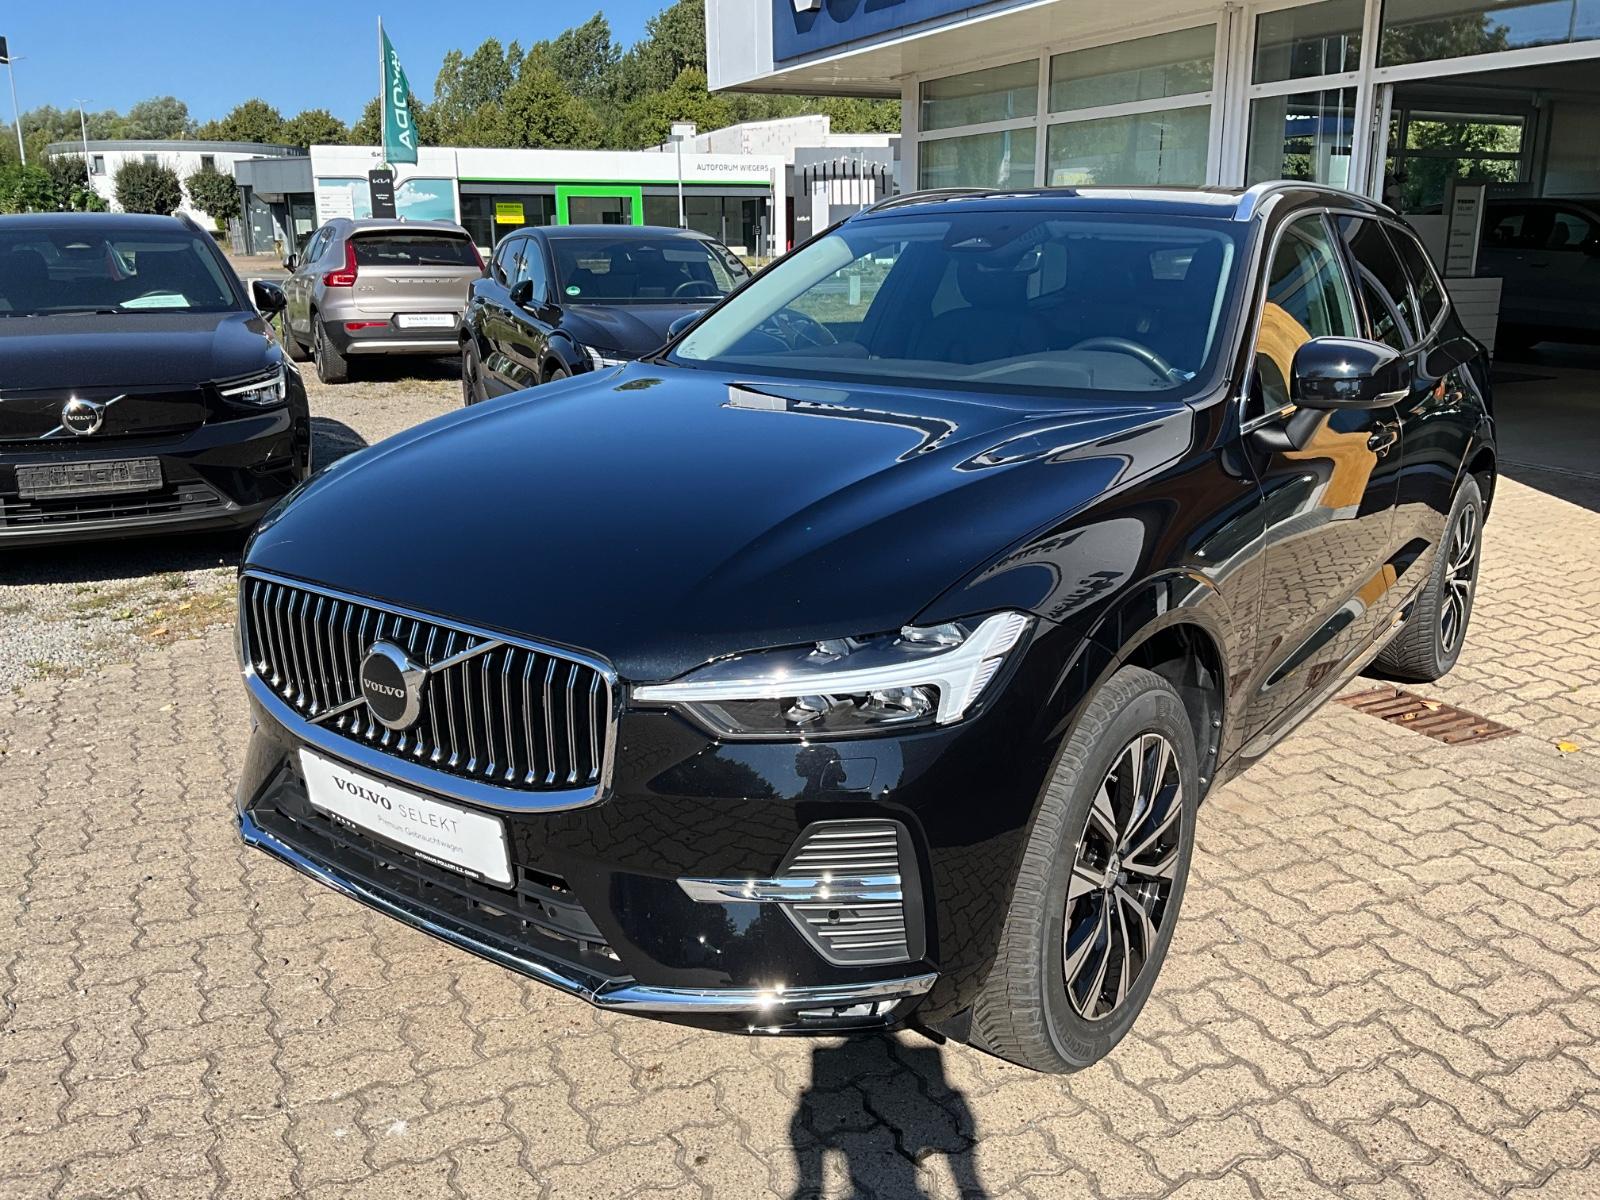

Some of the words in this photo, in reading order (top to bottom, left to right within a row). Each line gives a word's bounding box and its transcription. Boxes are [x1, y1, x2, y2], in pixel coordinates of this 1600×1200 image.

[697, 163, 738, 172] AUTOFORUM
[740, 164, 769, 172] WIEGERS
[363, 678, 405, 699] VOLVO
[332, 775, 393, 811] VOLVO
[398, 804, 457, 834] SELEKT
